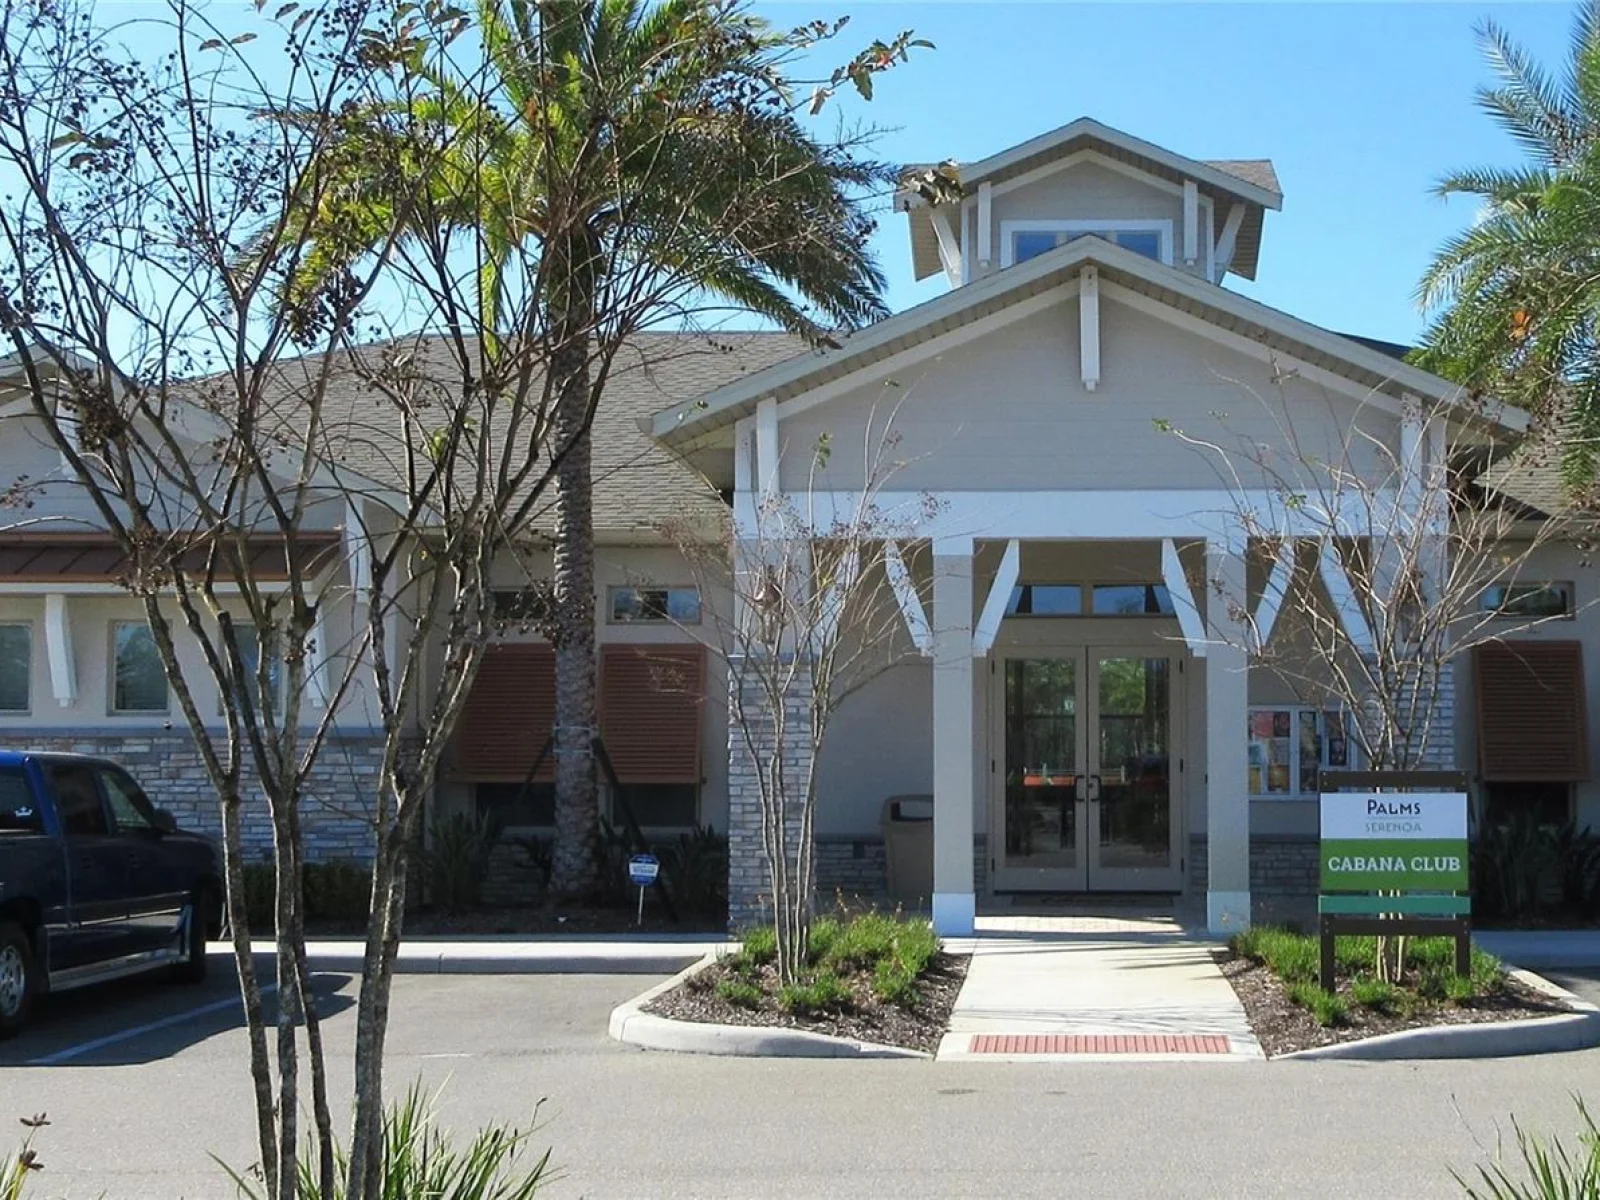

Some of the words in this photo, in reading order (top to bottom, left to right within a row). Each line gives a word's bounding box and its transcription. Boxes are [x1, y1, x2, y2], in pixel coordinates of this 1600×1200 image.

[1367, 799, 1420, 814] PALMS
[1365, 822, 1422, 833] SERENOA
[1328, 857, 1407, 871] CABANA
[1411, 857, 1461, 871] CLUB
